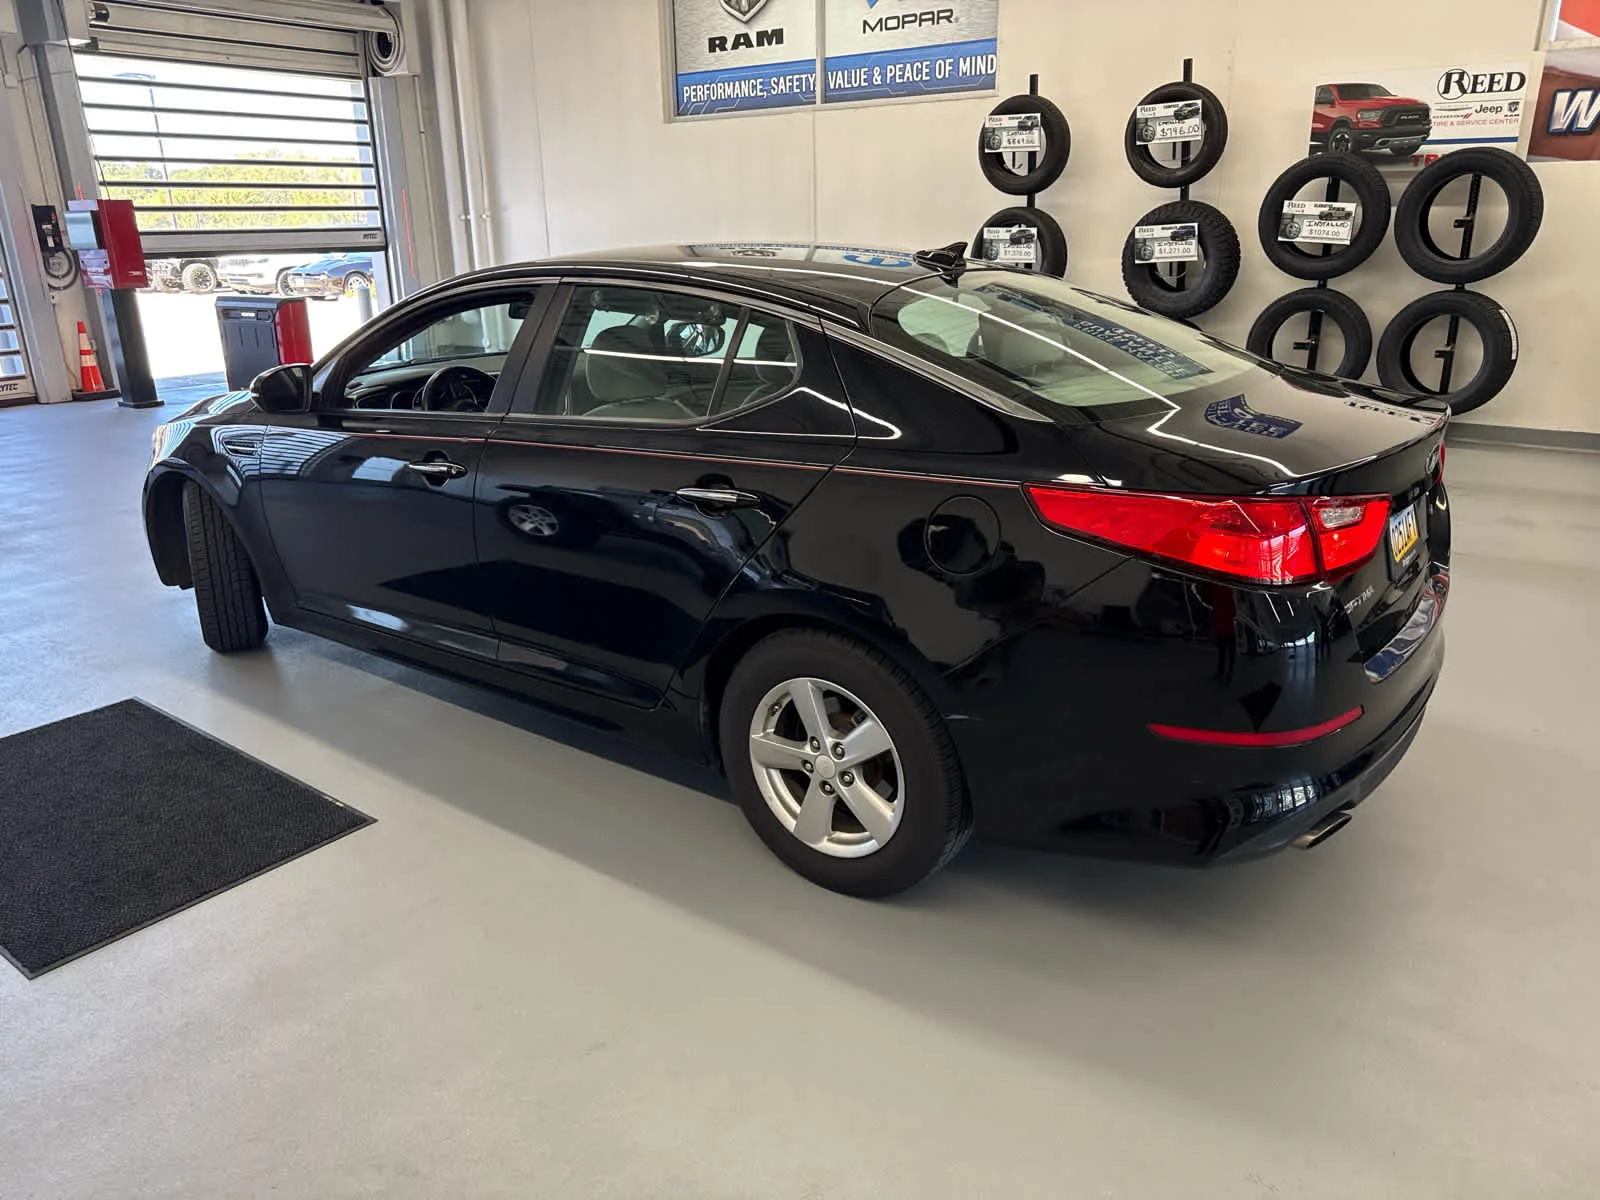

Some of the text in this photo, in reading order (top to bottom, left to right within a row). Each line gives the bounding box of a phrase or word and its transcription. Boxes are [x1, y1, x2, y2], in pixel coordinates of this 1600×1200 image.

[862, 8, 954, 34] MOPAR
[708, 28, 784, 53] RAM
[827, 54, 997, 89] VALUE & PEACE OF MIND
[1440, 70, 1526, 96] REED
[683, 78, 767, 103] PERFORMANCE,
[1475, 104, 1503, 114] Jeep
[0, 382, 19, 393] YTEC
